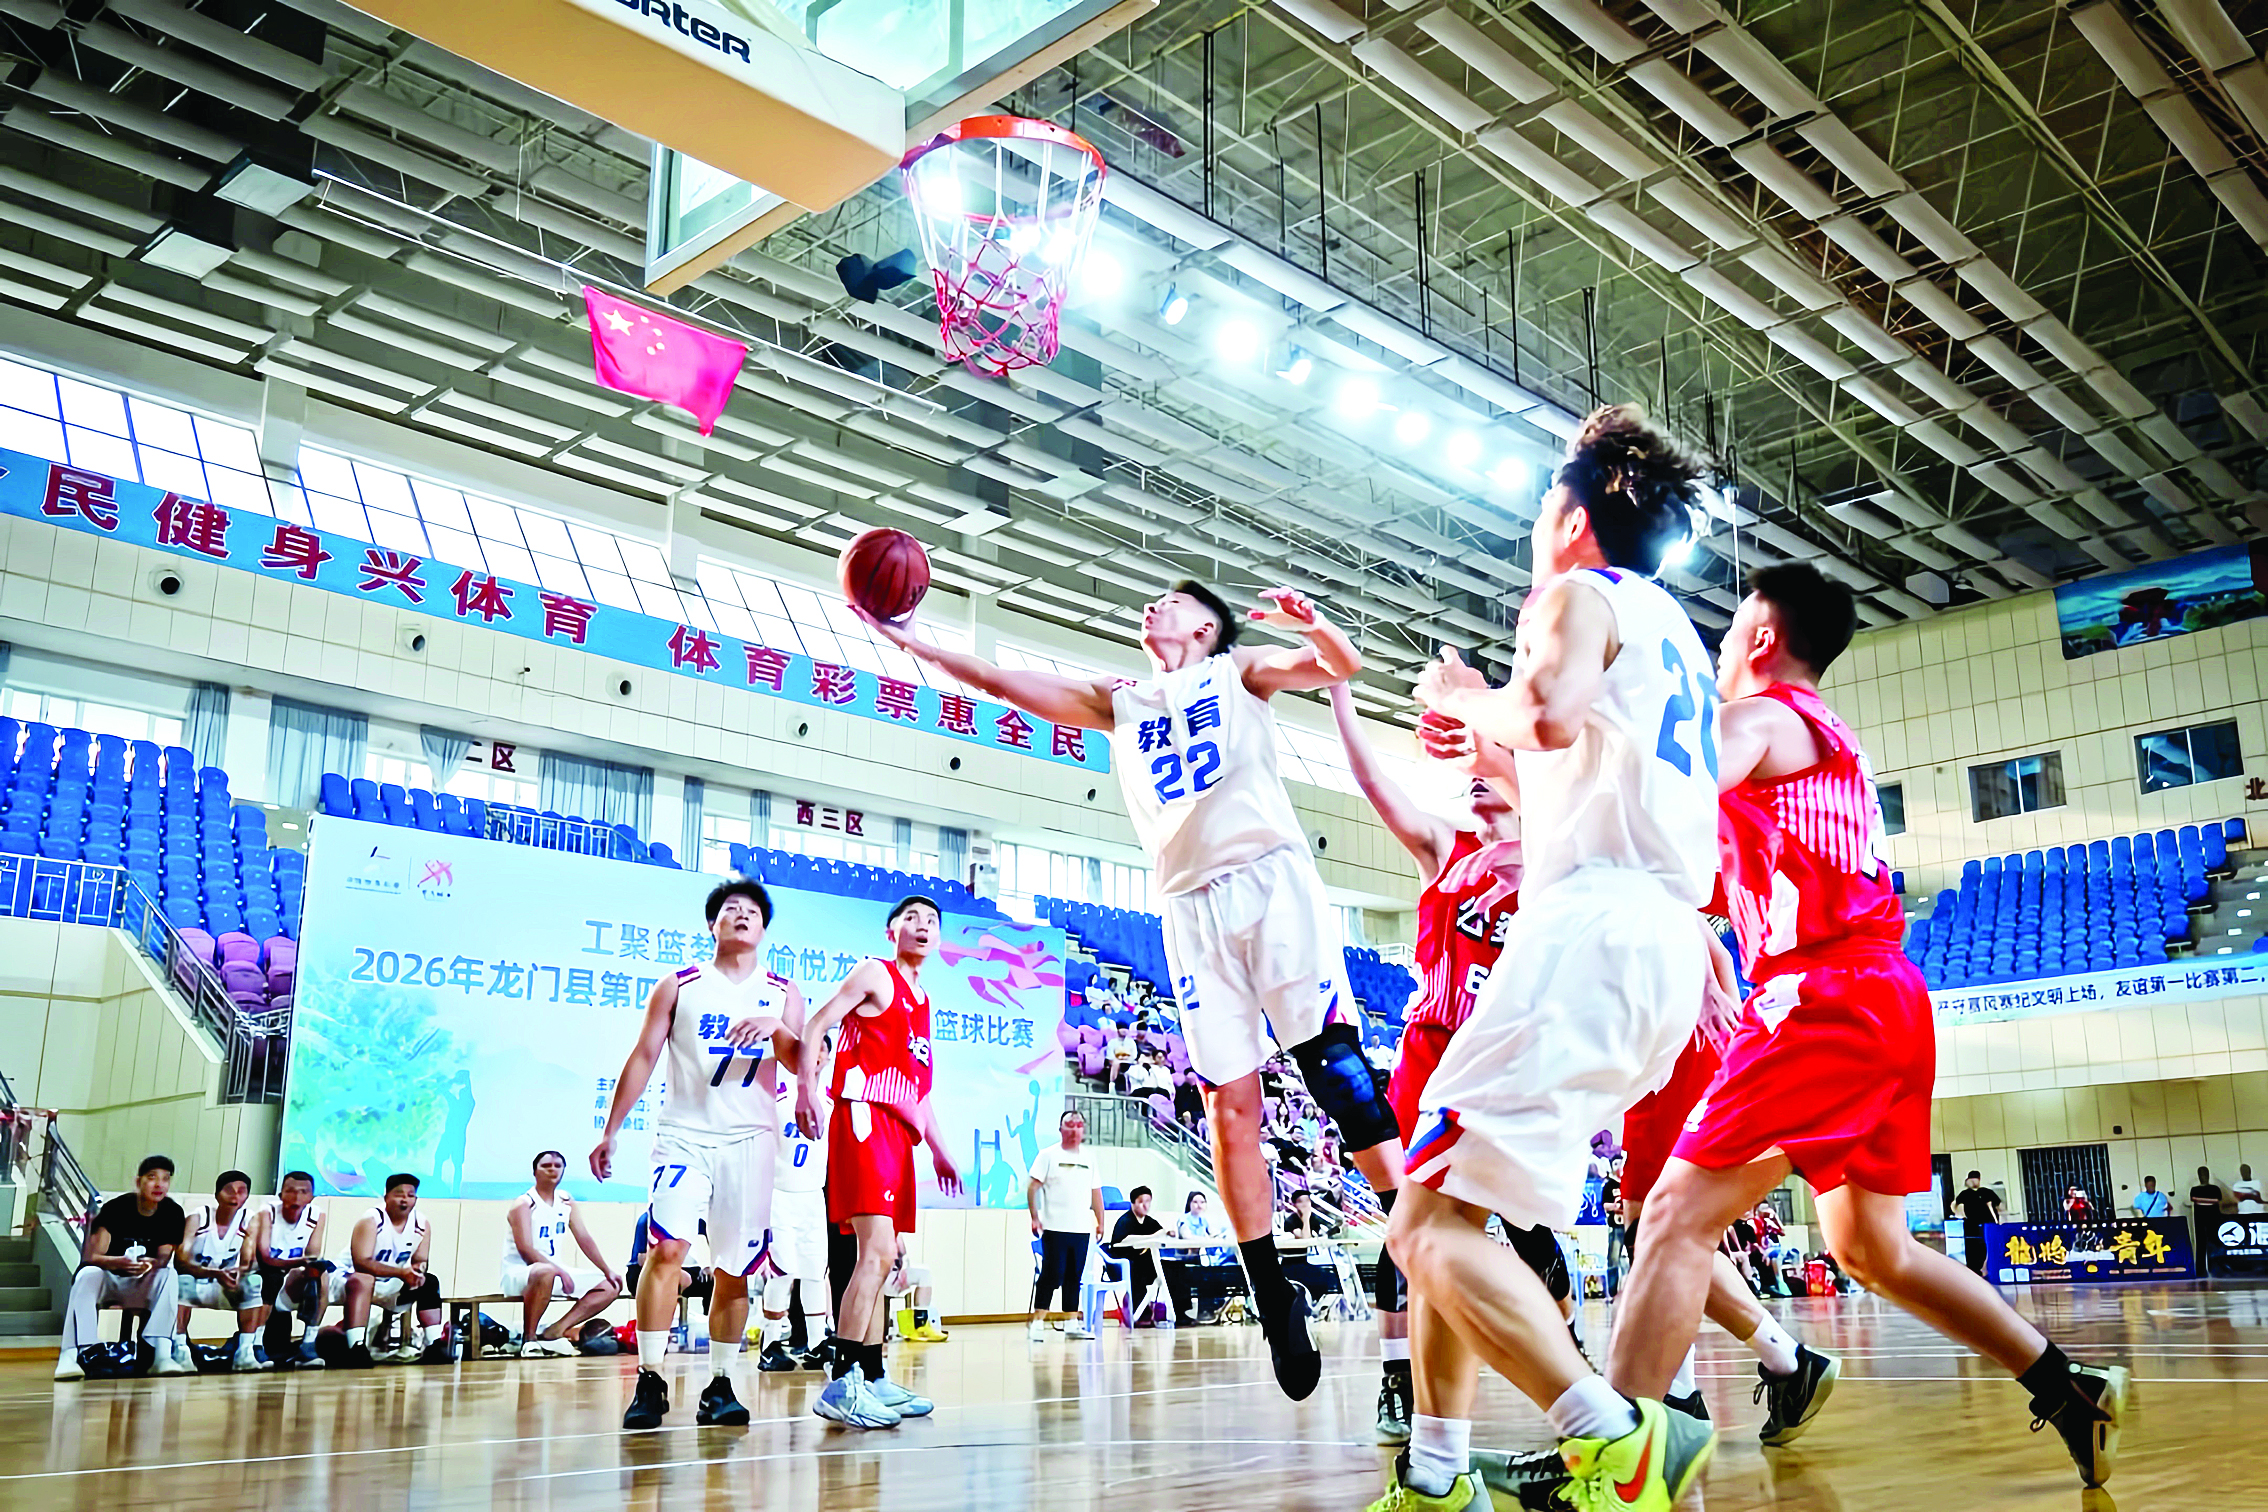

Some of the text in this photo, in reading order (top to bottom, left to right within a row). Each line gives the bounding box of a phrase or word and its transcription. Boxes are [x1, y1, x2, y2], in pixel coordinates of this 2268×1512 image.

[0, 461, 1087, 763] 民健身兴体育 体育彩票惠全民
[1138, 695, 1220, 754] 教育
[1151, 741, 1224, 805] 22
[796, 799, 864, 837] 西三区
[934, 1009, 1034, 1049] 篮球比赛
[709, 1046, 764, 1087] 77
